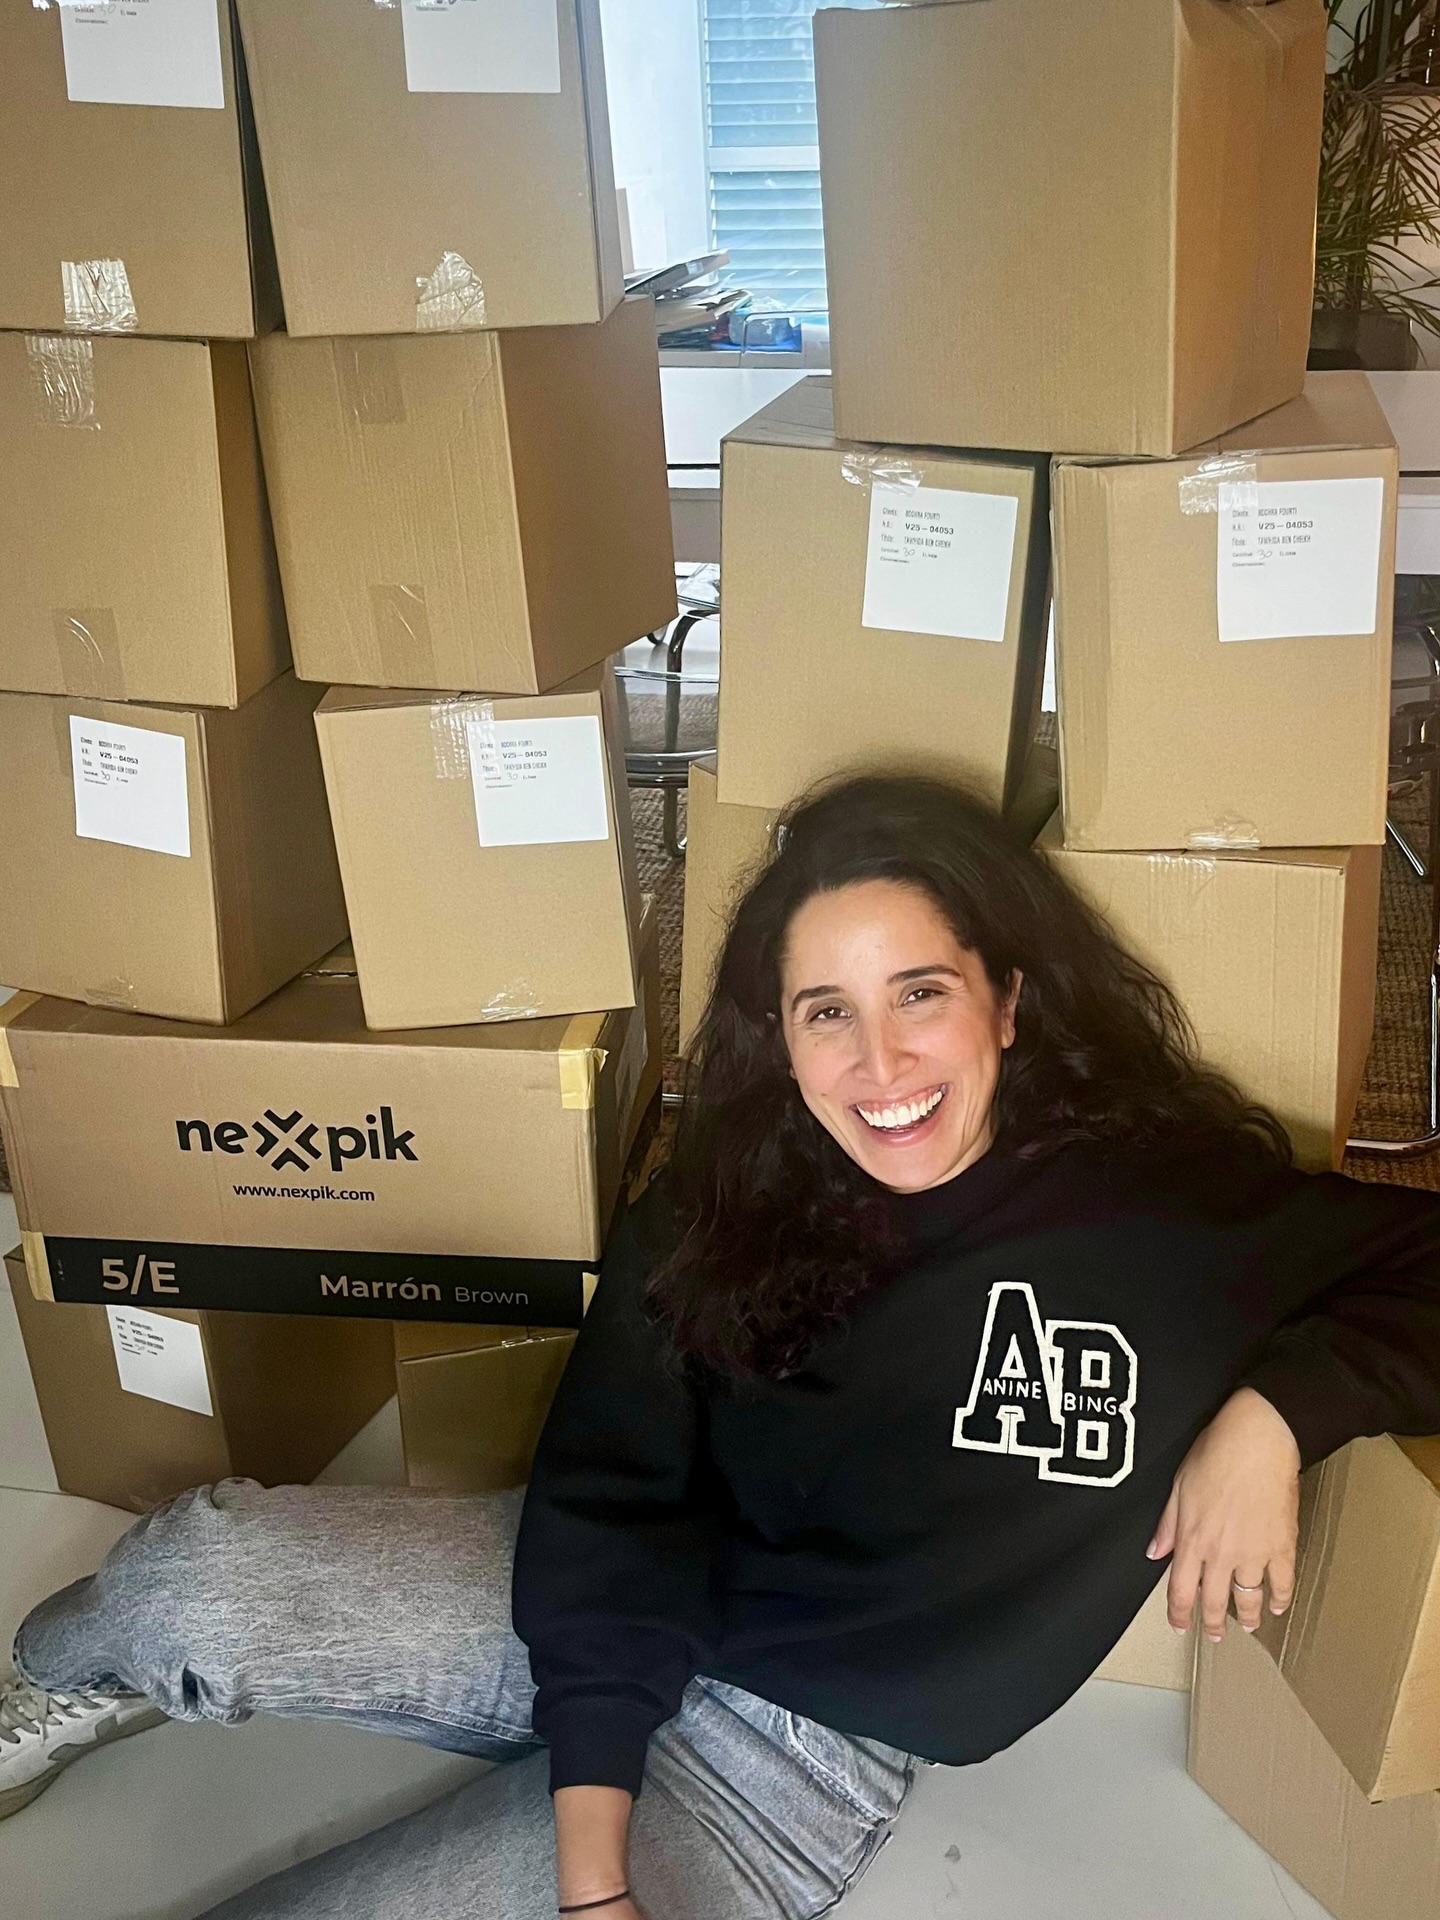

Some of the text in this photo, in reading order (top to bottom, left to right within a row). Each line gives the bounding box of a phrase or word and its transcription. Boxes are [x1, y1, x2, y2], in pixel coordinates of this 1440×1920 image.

[175, 1106, 419, 1172] nexpik
[232, 1184, 375, 1201] www.nexpik.com
[102, 1254, 180, 1295] 5/E
[320, 1274, 529, 1305] Marrón Brown
[982, 1378, 1117, 1416] ANINE BING
